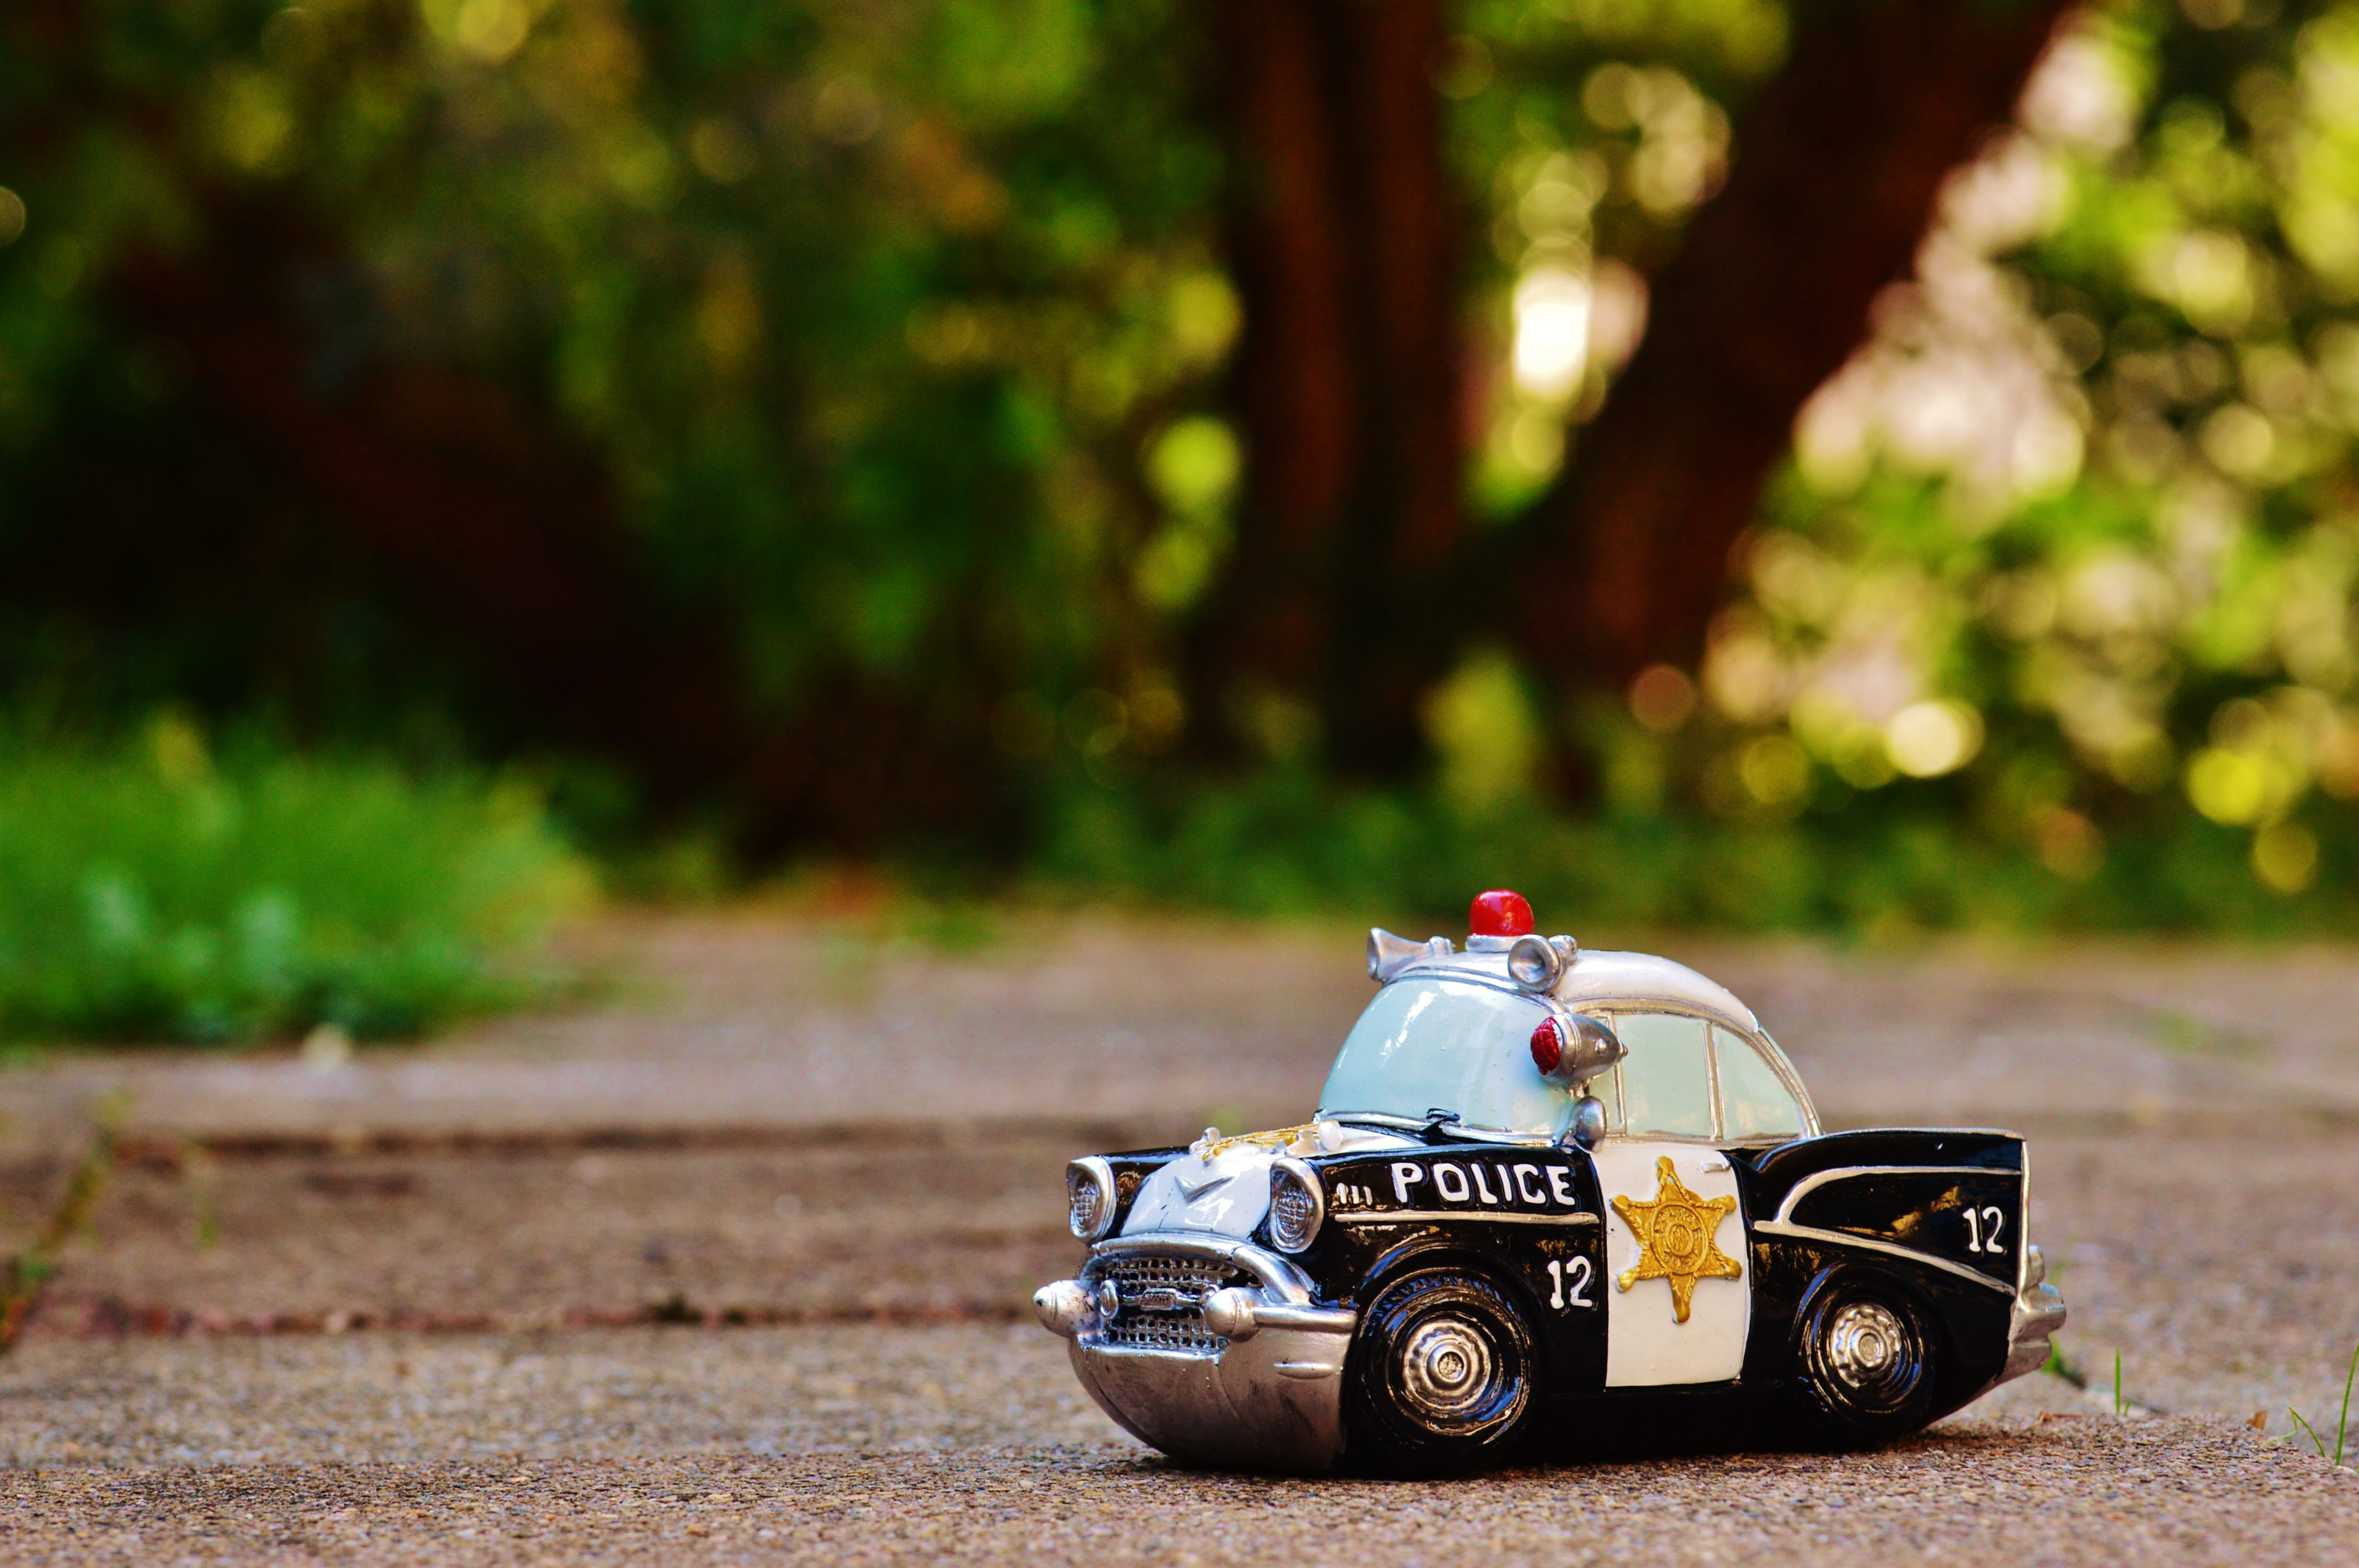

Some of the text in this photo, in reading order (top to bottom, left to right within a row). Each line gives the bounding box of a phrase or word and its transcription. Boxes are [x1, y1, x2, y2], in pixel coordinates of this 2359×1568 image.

[1391, 1162, 1575, 1205] POLICE
[1962, 1206, 2003, 1253] 12
[1547, 1255, 1593, 1309] 12
